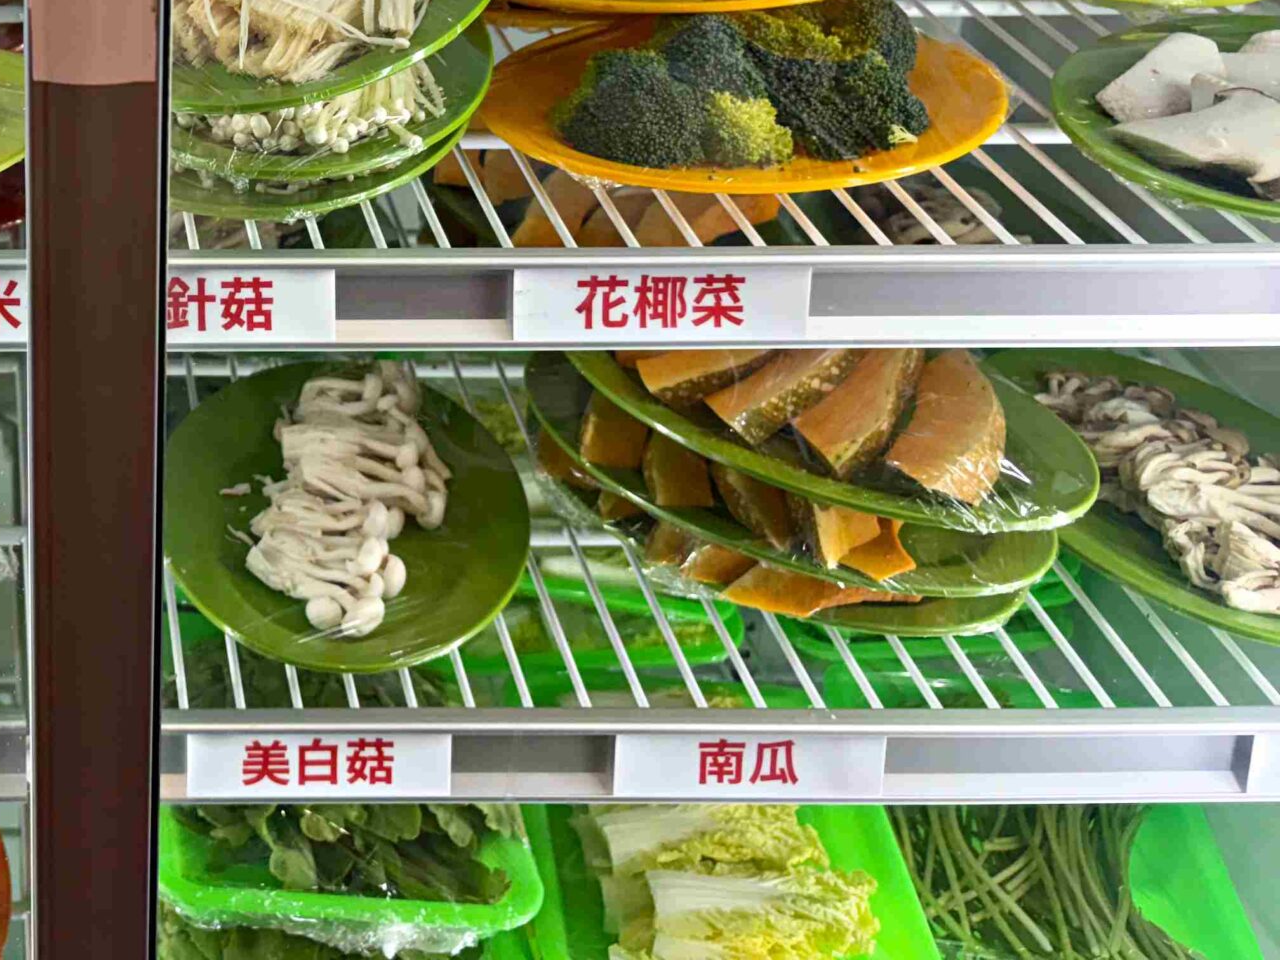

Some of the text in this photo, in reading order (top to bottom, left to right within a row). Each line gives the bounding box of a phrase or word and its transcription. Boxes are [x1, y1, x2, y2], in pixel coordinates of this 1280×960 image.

[167, 276, 274, 332] 針菇
[575, 273, 746, 329] 花椰菜
[242, 738, 394, 786] 美白菇
[697, 739, 799, 785] 南瓜
